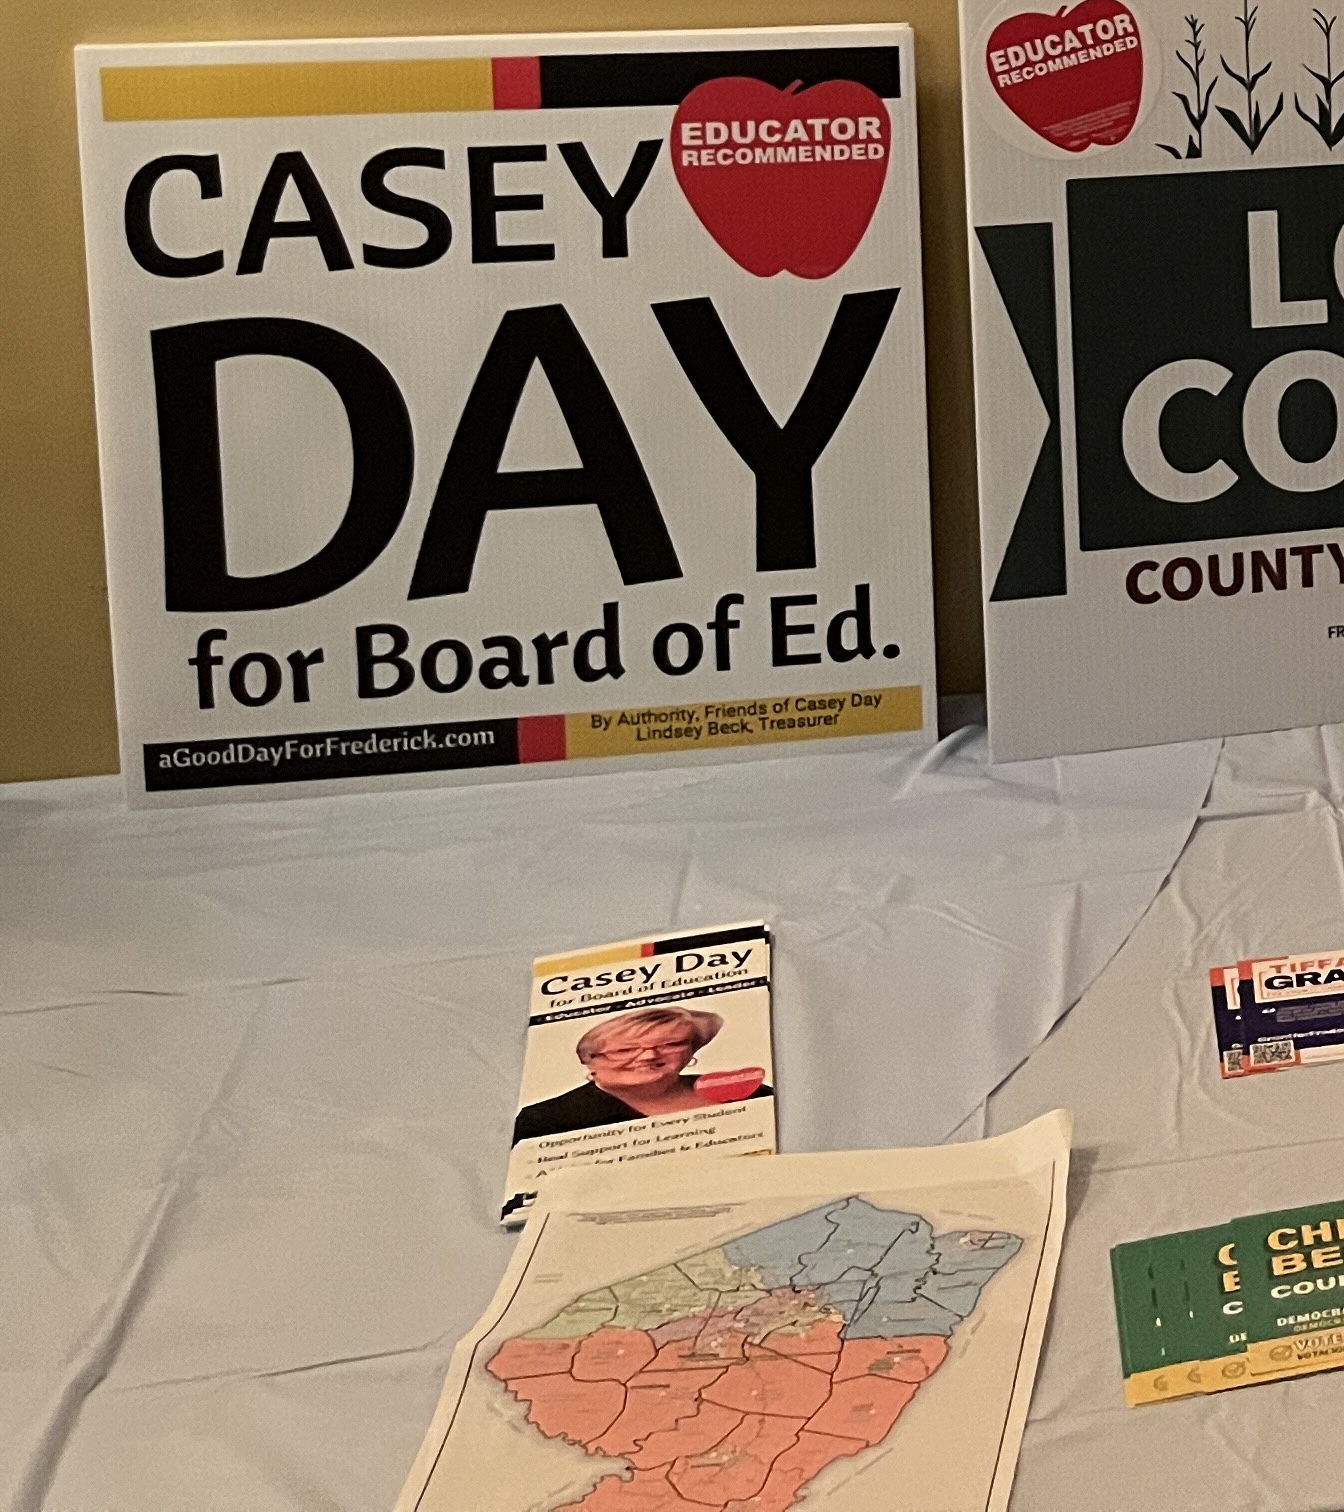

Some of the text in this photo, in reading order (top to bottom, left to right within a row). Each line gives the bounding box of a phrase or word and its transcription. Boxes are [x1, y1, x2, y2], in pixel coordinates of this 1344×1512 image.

[990, 13, 1134, 73] EDUCATOR
[997, 36, 1138, 88] RECOMMENDED
[681, 116, 883, 147] EDUCATOR
[681, 143, 885, 167] RECOMMENDED
[123, 138, 663, 279] CASEY
[149, 287, 902, 613] DAY
[189, 583, 902, 710] for Board of Ed.
[590, 693, 883, 731] By Authority, Friends of Casey Day
[636, 713, 840, 742] Lindsey Beck, Treasurer
[157, 726, 496, 771] aGoodDayForFrederick.com
[540, 948, 752, 996] Casey Day
[580, 986, 632, 1003] Board
[660, 968, 748, 990] Education
